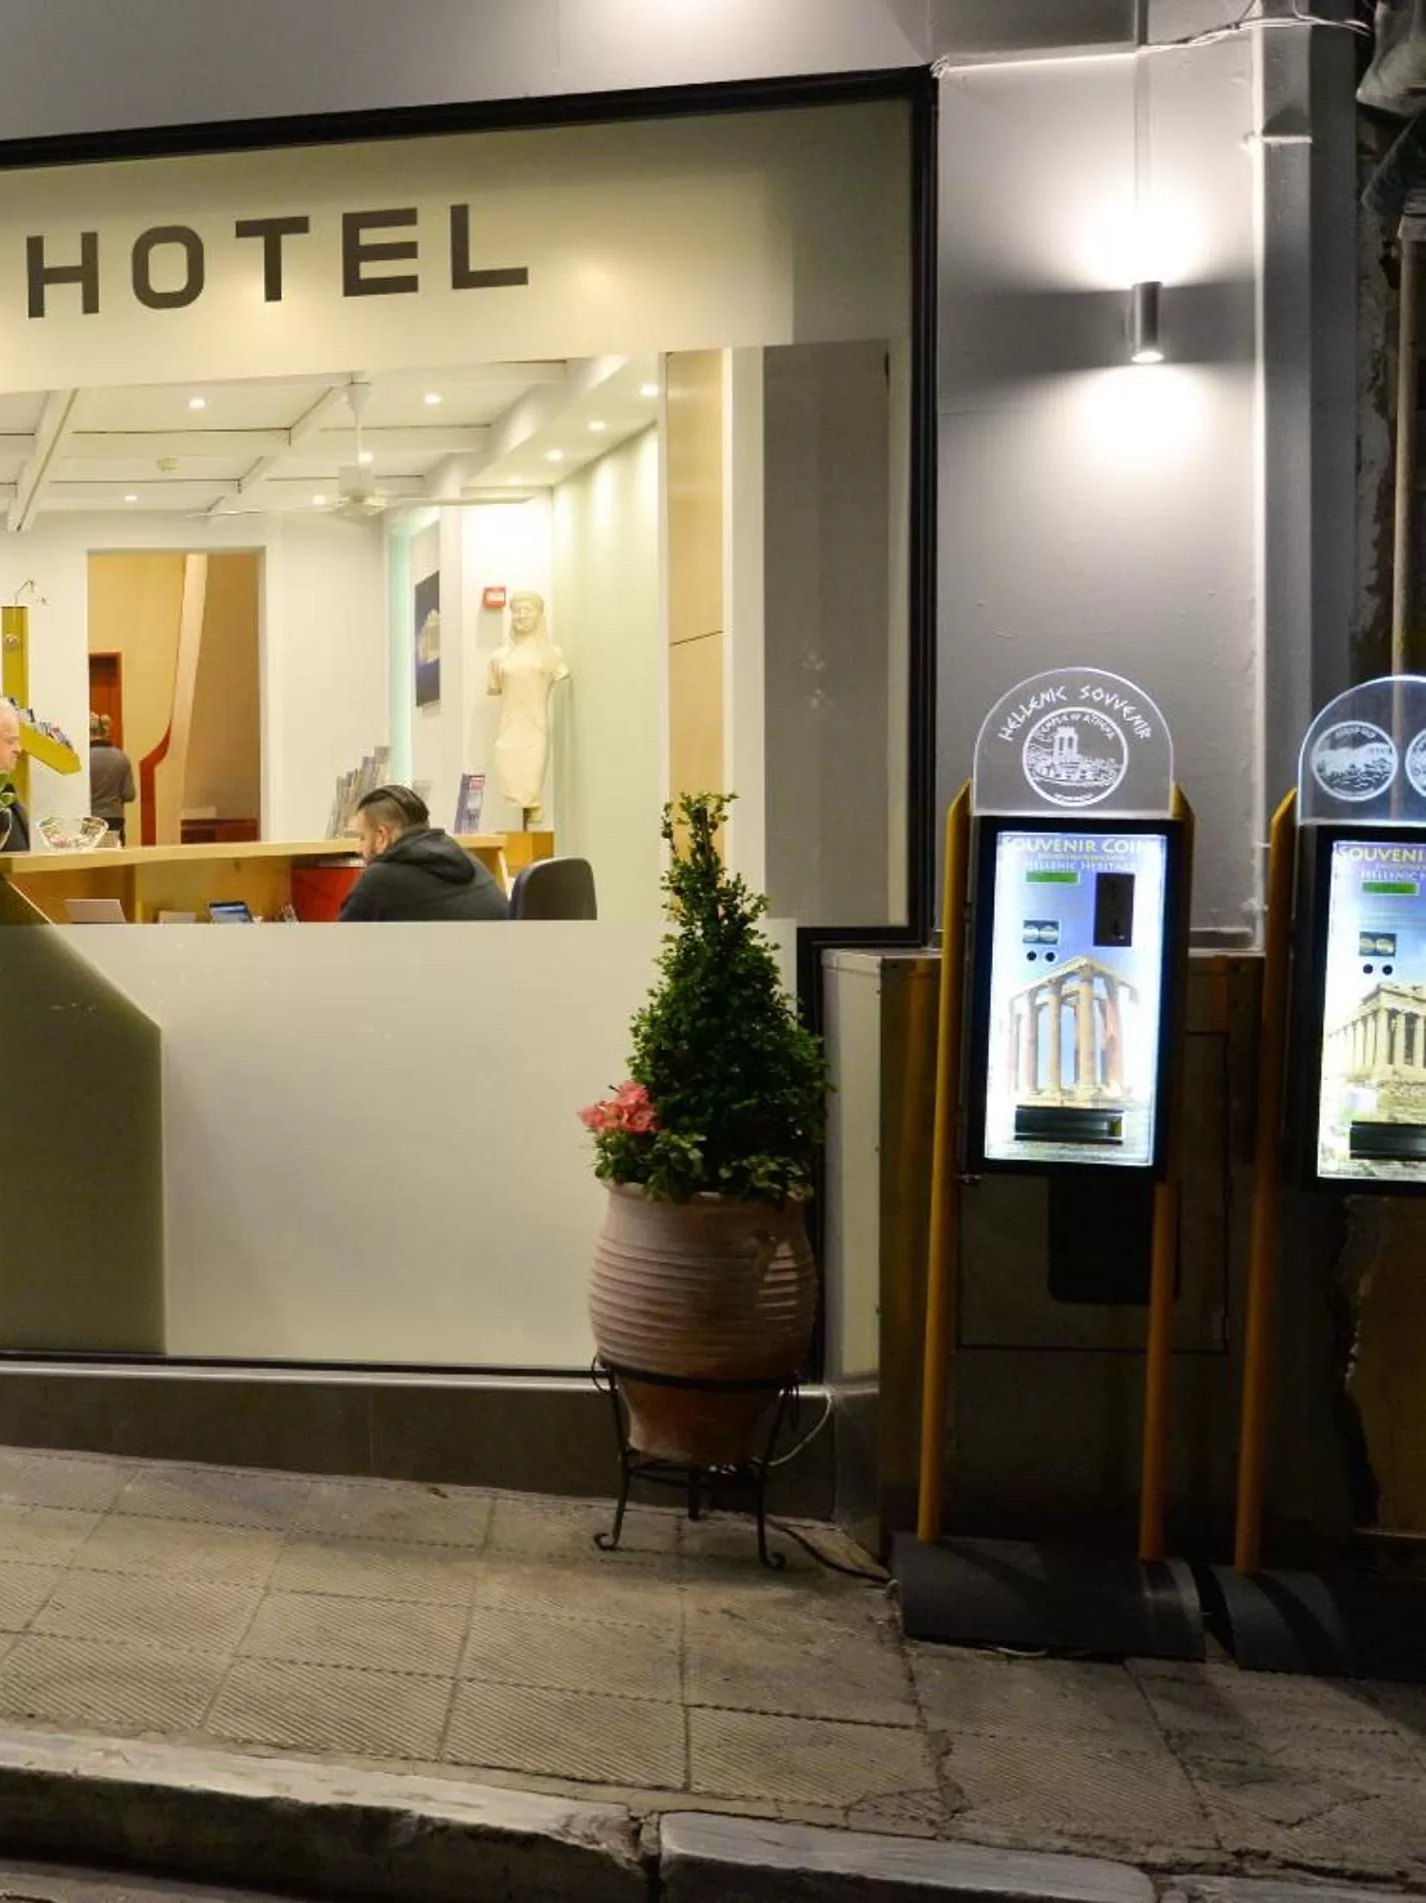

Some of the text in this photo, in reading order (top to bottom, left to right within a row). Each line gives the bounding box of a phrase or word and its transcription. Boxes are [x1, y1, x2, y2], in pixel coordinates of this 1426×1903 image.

[26, 203, 529, 320] HOTEL
[1002, 835, 1097, 853] SOUVENIR
[1340, 846, 1426, 861] SOUVENI
